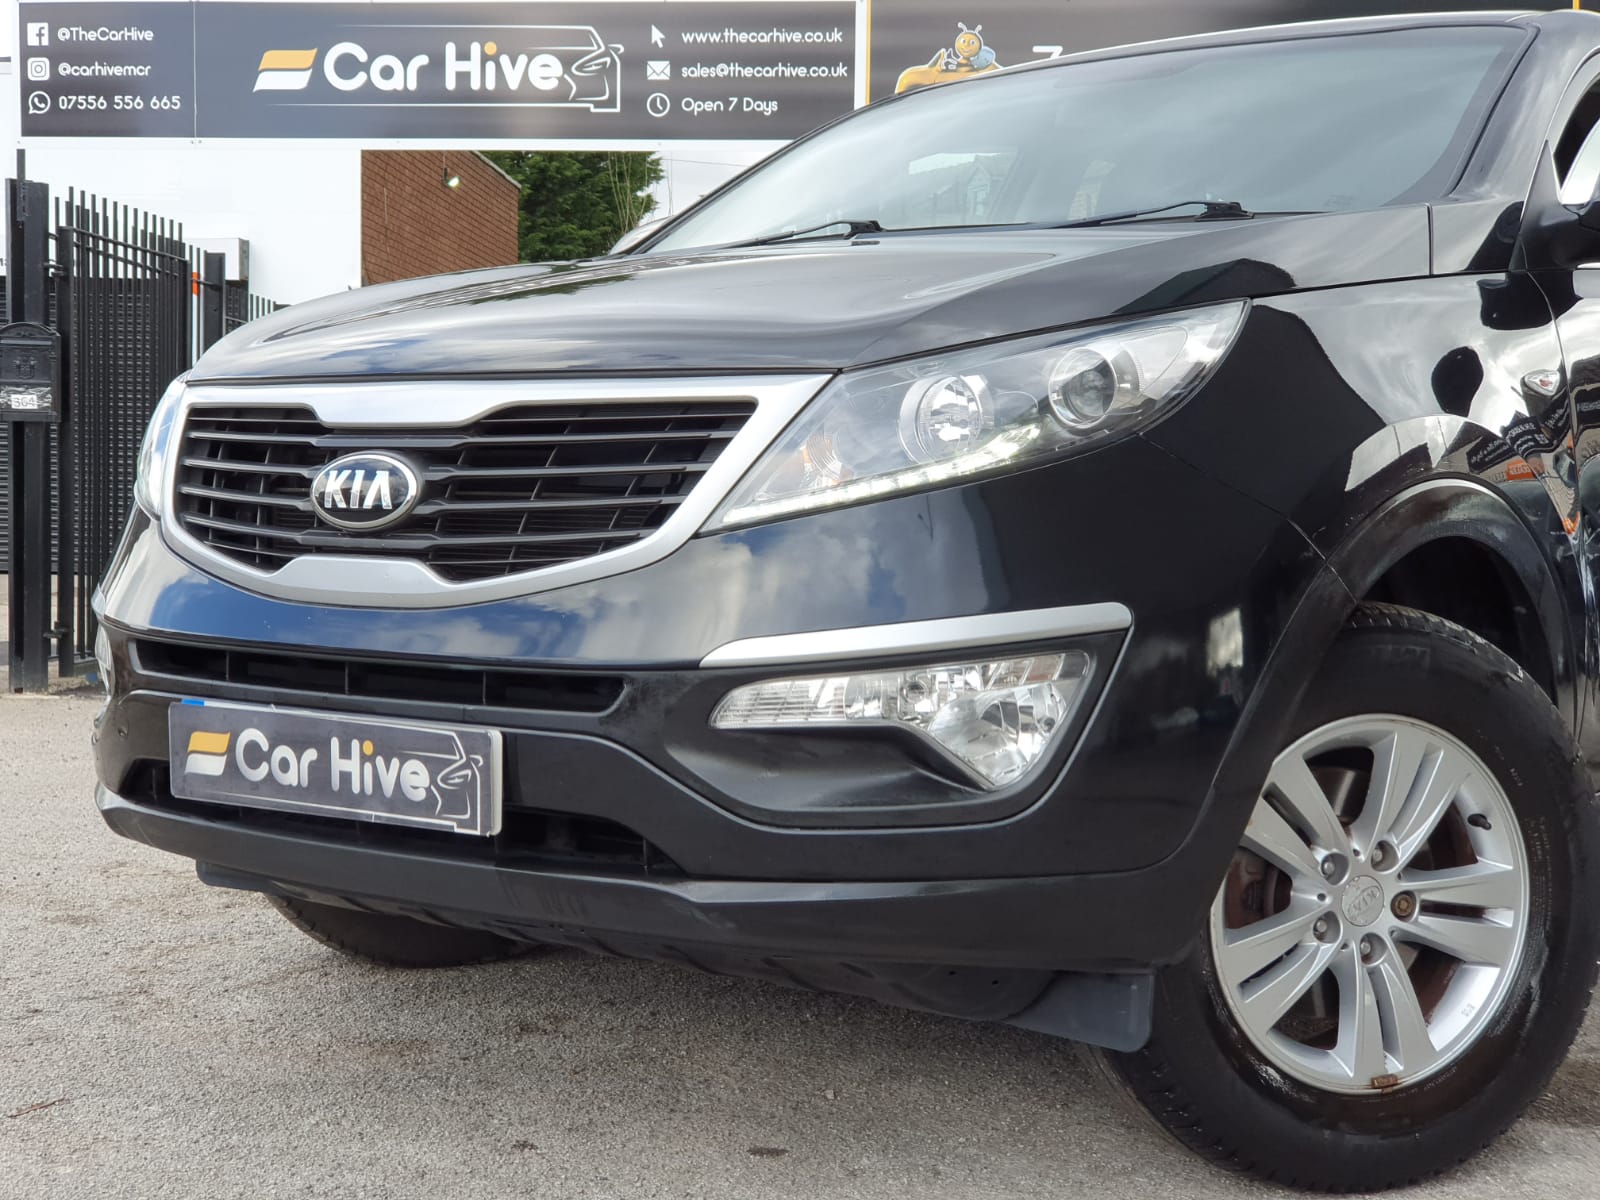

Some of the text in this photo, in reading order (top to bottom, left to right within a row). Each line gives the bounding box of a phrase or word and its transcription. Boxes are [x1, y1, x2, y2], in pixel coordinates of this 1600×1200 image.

[57, 27, 154, 42] @TheCarHive
[681, 28, 843, 44] www.thecarhive.co.uk
[58, 62, 152, 77] @carhivemcr
[323, 42, 564, 91] Car Hive
[681, 63, 848, 78] sales@thecarhive.co.uk
[58, 95, 181, 110] 07556 556 665
[681, 97, 778, 116] Open 7 Days
[323, 469, 393, 510] KIA
[235, 728, 431, 802] Car Hive
